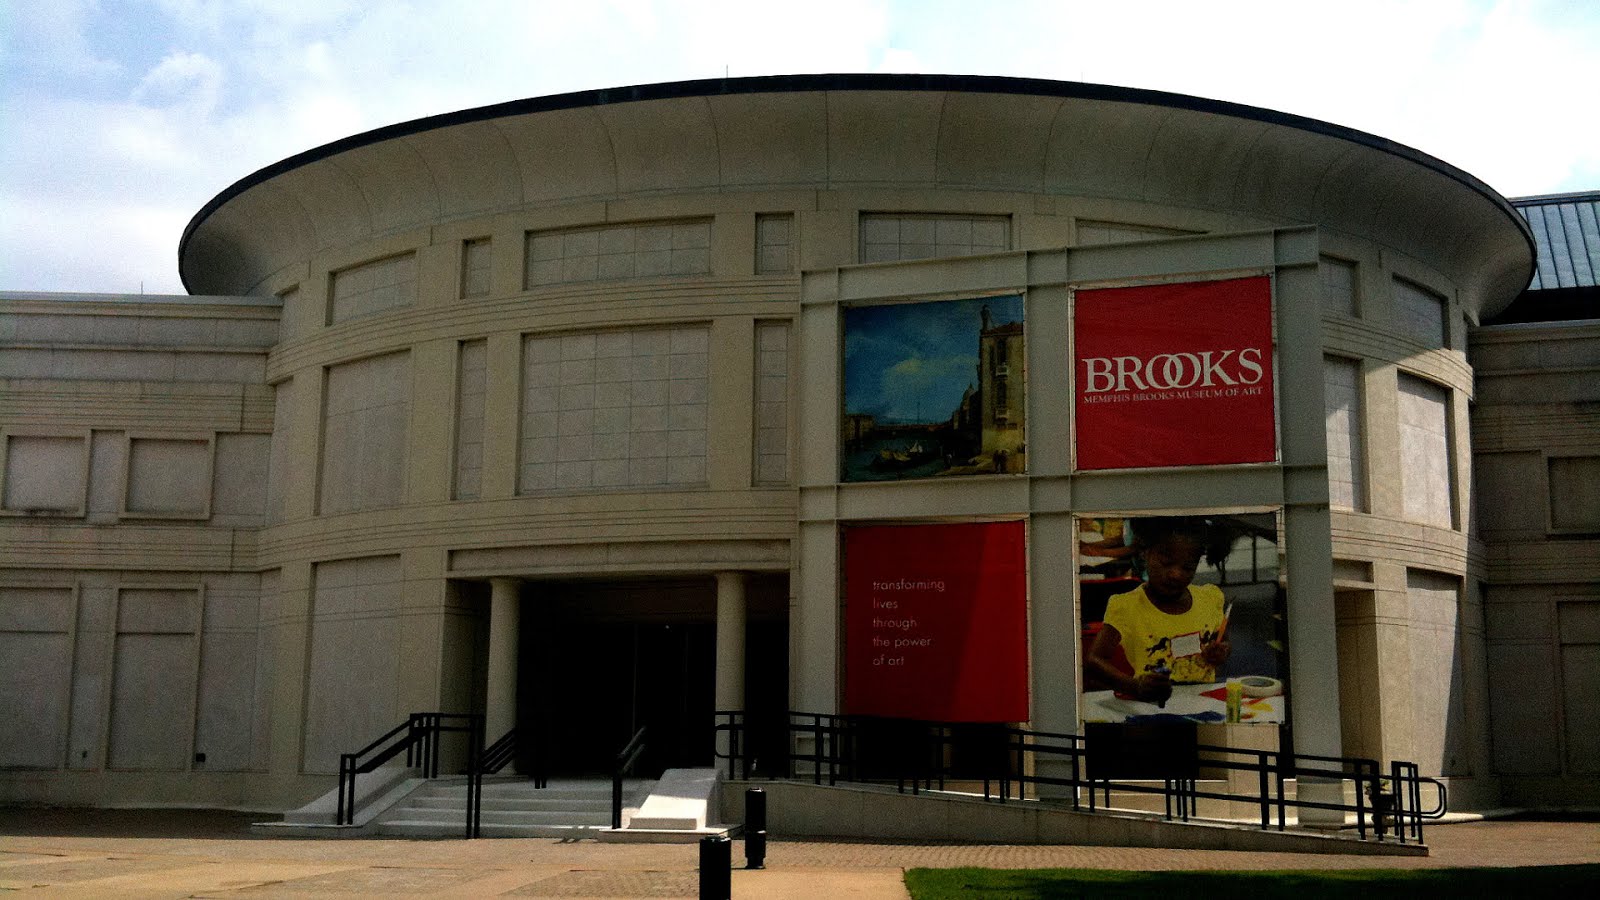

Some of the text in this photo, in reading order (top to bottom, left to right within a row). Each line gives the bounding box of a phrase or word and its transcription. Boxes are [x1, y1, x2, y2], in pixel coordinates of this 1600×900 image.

[1082, 348, 1264, 393] BROOKS
[1083, 386, 1264, 404] MEMPHIS BROOKS MUSEUM OF ART
[872, 578, 945, 592] transforming
[873, 597, 899, 609] lives
[872, 616, 918, 631] through
[872, 636, 932, 649] the power
[872, 654, 905, 666] of art
